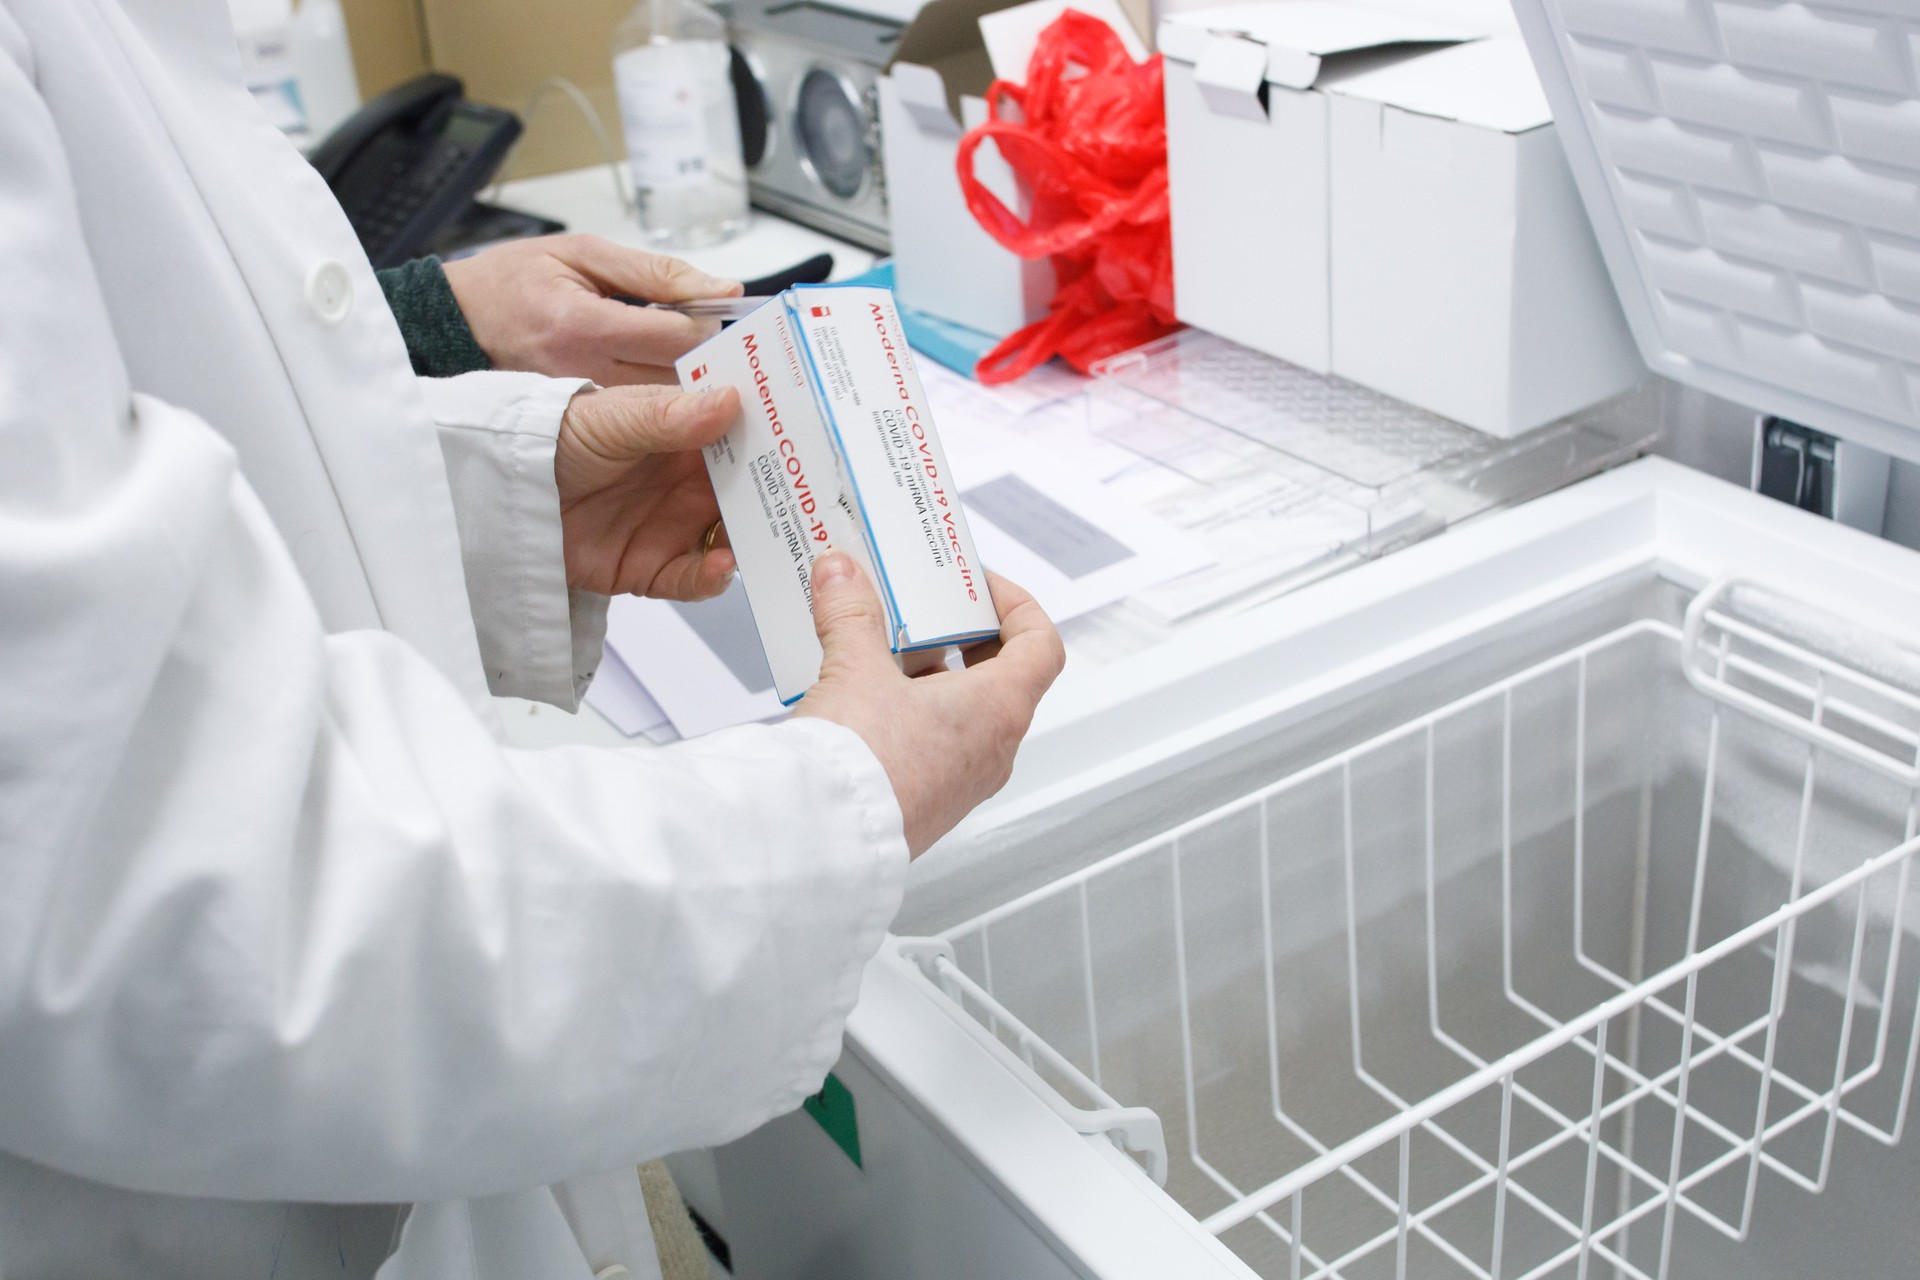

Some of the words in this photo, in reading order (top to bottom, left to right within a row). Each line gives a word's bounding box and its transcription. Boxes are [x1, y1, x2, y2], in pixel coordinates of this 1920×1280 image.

[775, 315, 805, 386] moderna
[742, 334, 783, 435] Moderna
[779, 438, 828, 542] COVID-19
[869, 303, 909, 399] Moderna
[905, 406, 947, 506] COVID-19
[943, 511, 978, 601] Vaccine
[872, 412, 896, 467] Intramuscular
[892, 471, 903, 487] Use
[748, 461, 772, 519] Intramuscular
[769, 520, 779, 538] Use
[757, 455, 787, 517] COVID-19
[781, 521, 802, 561] mRNA
[788, 504, 811, 556] Suspension
[882, 410, 912, 469] COVID-19
[905, 476, 926, 514] mRNA
[922, 519, 944, 566] vaccine
[913, 464, 933, 509] Suspension
[930, 513, 939, 524] for
[936, 528, 952, 562] Injection
